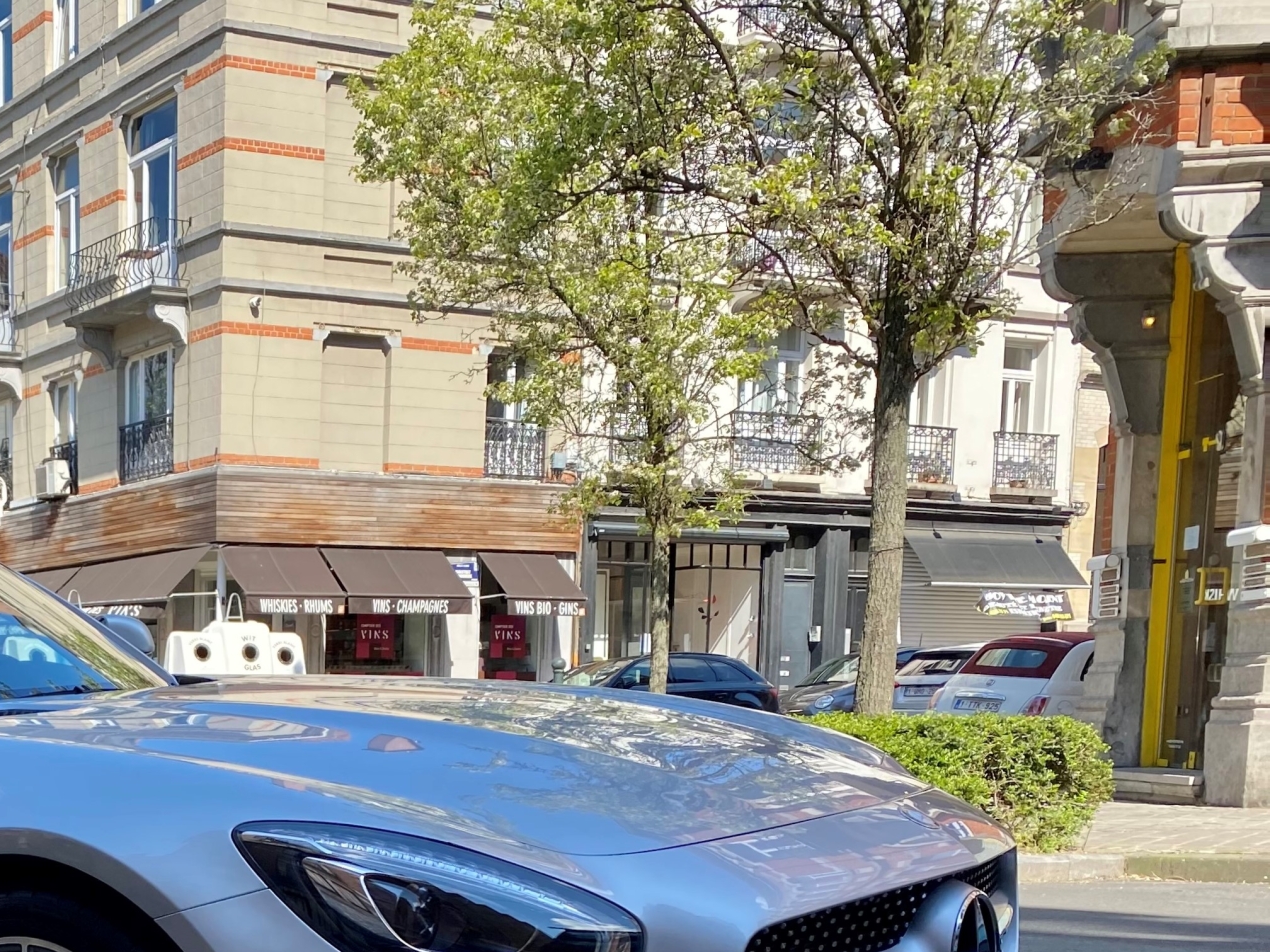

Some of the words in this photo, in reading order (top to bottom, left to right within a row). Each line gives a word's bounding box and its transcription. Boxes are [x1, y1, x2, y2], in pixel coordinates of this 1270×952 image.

[260, 598, 298, 613] WHISKIES
[304, 599, 333, 614] RHUMS
[373, 598, 390, 613] VINS
[397, 598, 449, 614] CHAMPAGNES
[515, 601, 535, 615] VINS
[536, 602, 552, 615] BIO
[558, 602, 579, 616] GINS
[241, 634, 256, 642] WIT
[361, 629, 389, 639] VINS
[494, 630, 521, 640] VINS
[244, 663, 262, 671] GLAS
